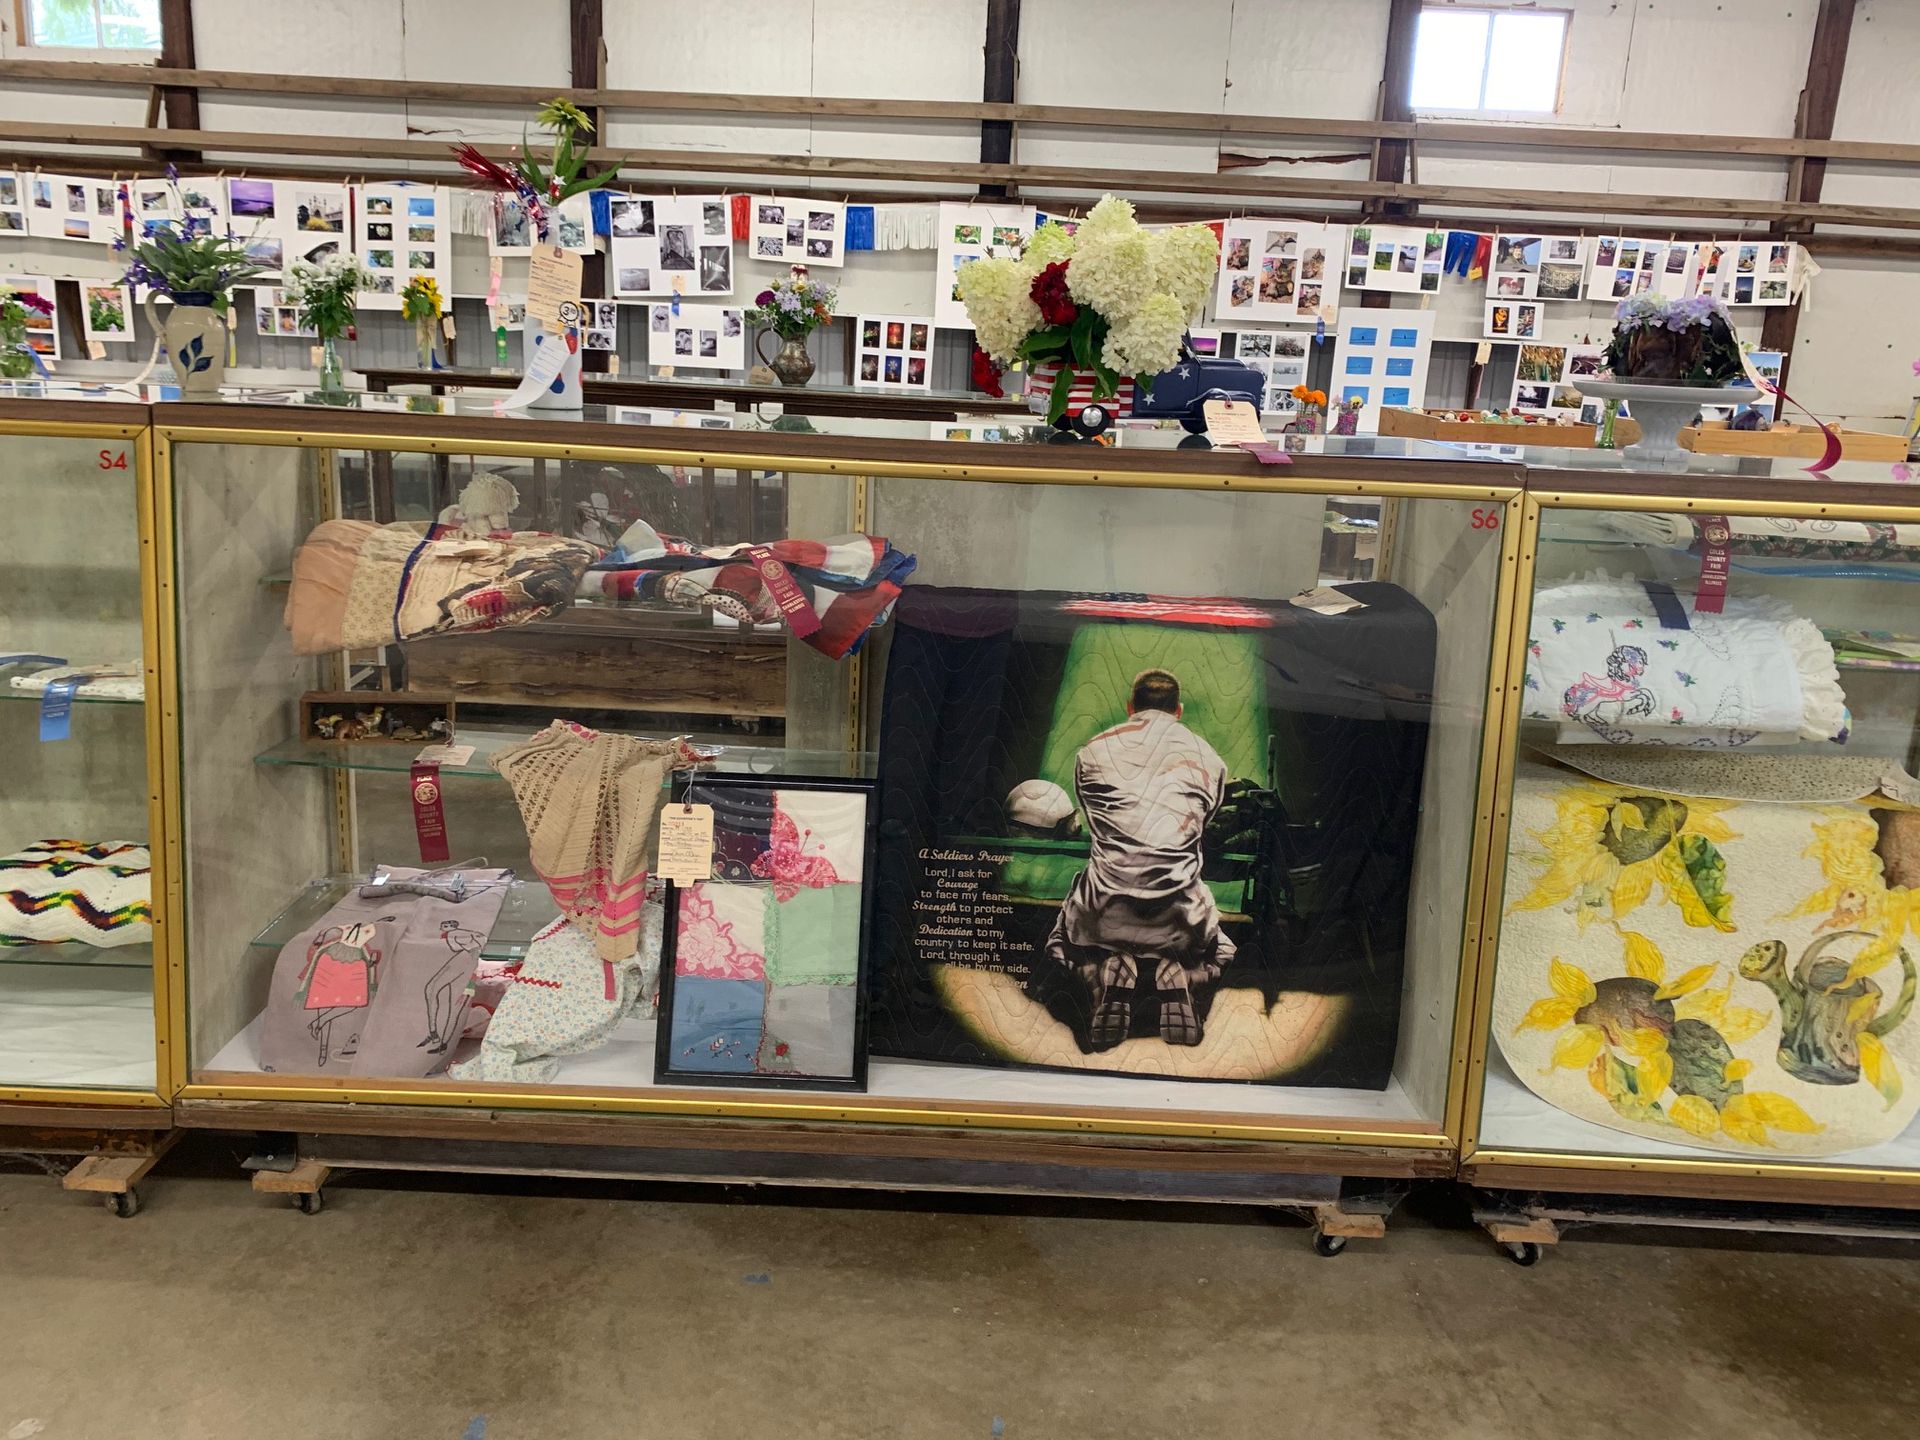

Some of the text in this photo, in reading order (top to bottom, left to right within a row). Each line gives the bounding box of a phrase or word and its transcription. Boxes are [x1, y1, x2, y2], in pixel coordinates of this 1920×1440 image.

[99, 450, 127, 469] S4
[1471, 509, 1498, 529] S6
[919, 849, 1014, 865] A Soldiers Prayer
[925, 867, 951, 878] Lord,
[958, 869, 975, 878] ask
[977, 869, 992, 879] for
[937, 879, 978, 891] Courage
[921, 890, 932, 899] to
[936, 890, 958, 899] face
[962, 893, 977, 902] my
[912, 901, 1014, 916] Strength to protect
[936, 915, 993, 925] others and
[919, 924, 1004, 939] Dedication to my
[914, 938, 1035, 951] country to keep it safe.
[950, 950, 990, 962] through
[993, 952, 1001, 962] it
[989, 965, 1004, 973] my
